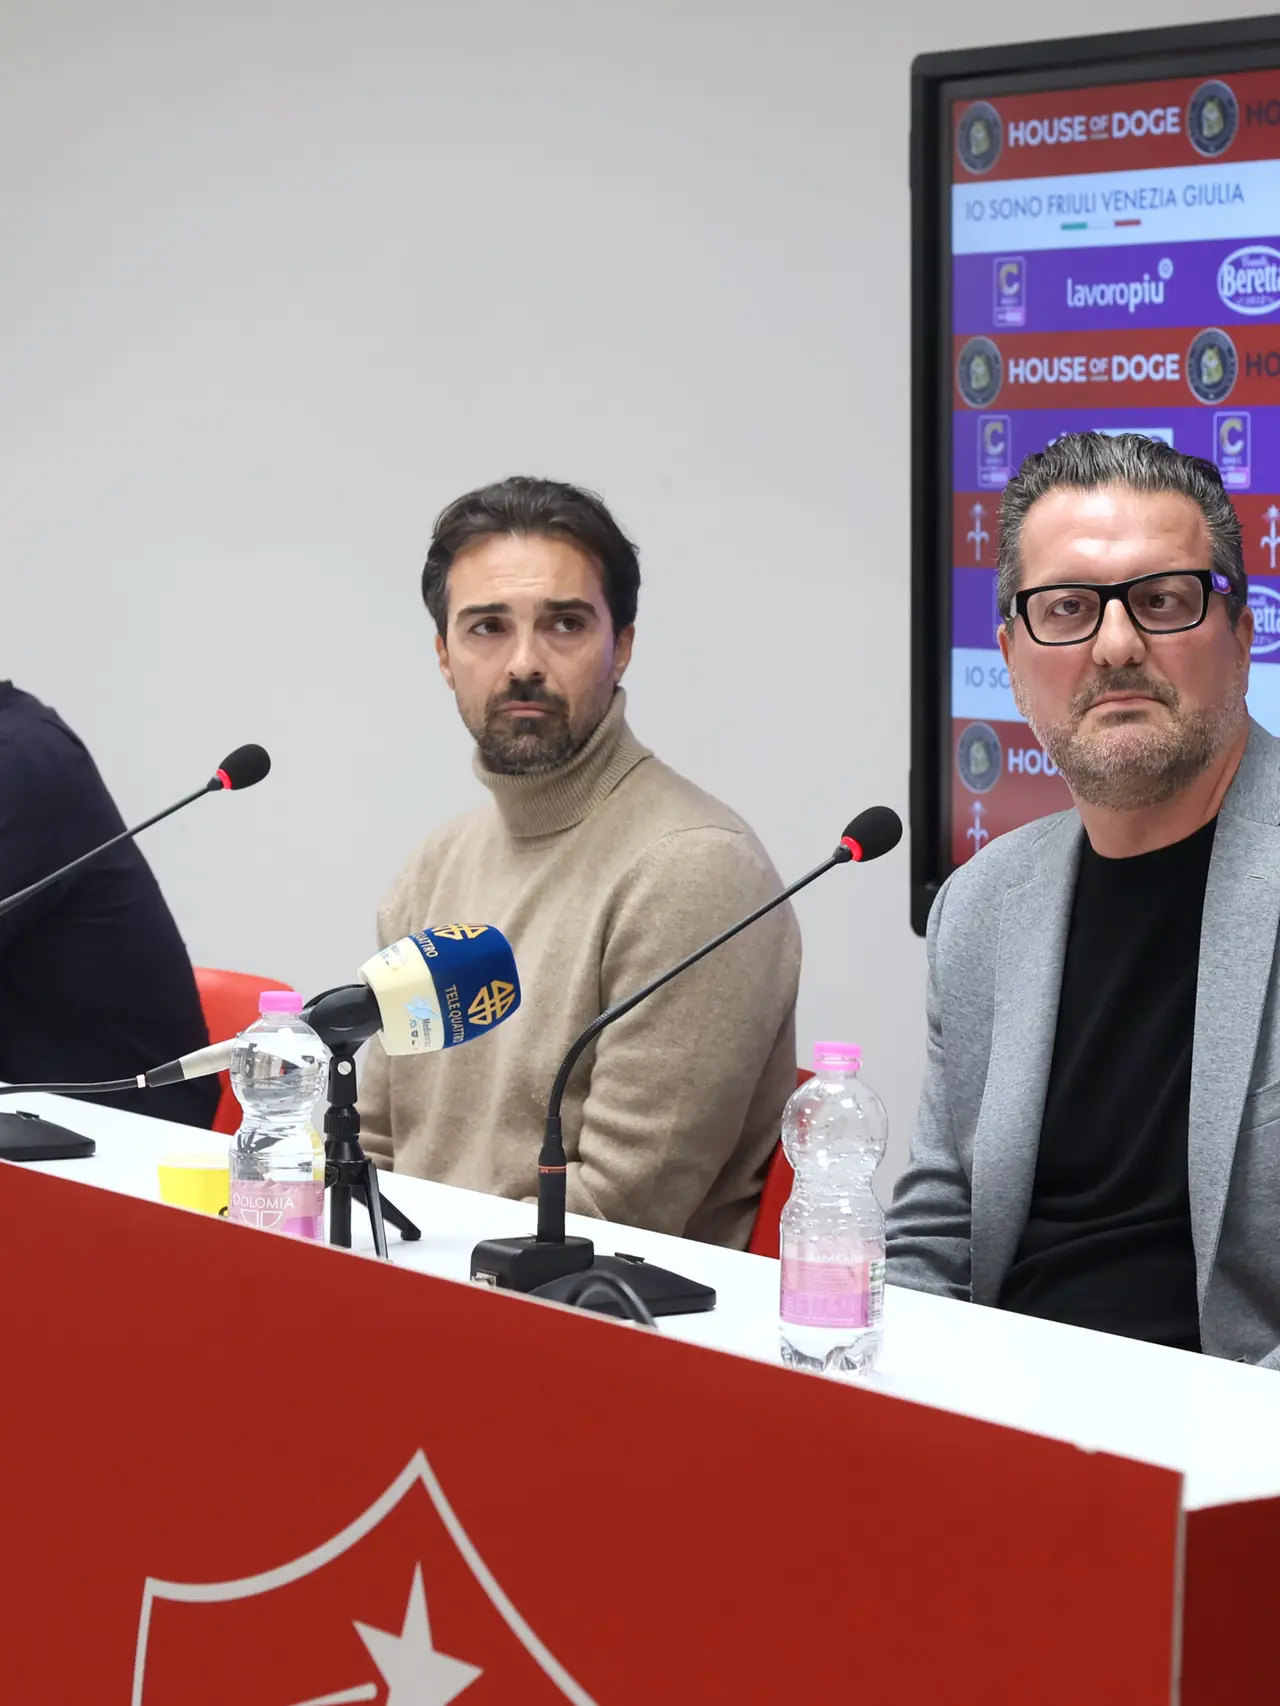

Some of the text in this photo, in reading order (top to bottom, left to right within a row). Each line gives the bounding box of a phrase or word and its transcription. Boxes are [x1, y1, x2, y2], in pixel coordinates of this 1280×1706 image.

[1008, 106, 1182, 148] HOUSE OF DOGE
[965, 183, 1245, 221] IO SONO FRIULI VENEZIA GIULIA
[1008, 353, 1182, 384] HOUSE OF DOGE
[965, 665, 1011, 689] IO SO
[1007, 746, 1058, 777] HOU
[233, 1192, 294, 1210] DOLOMIA
